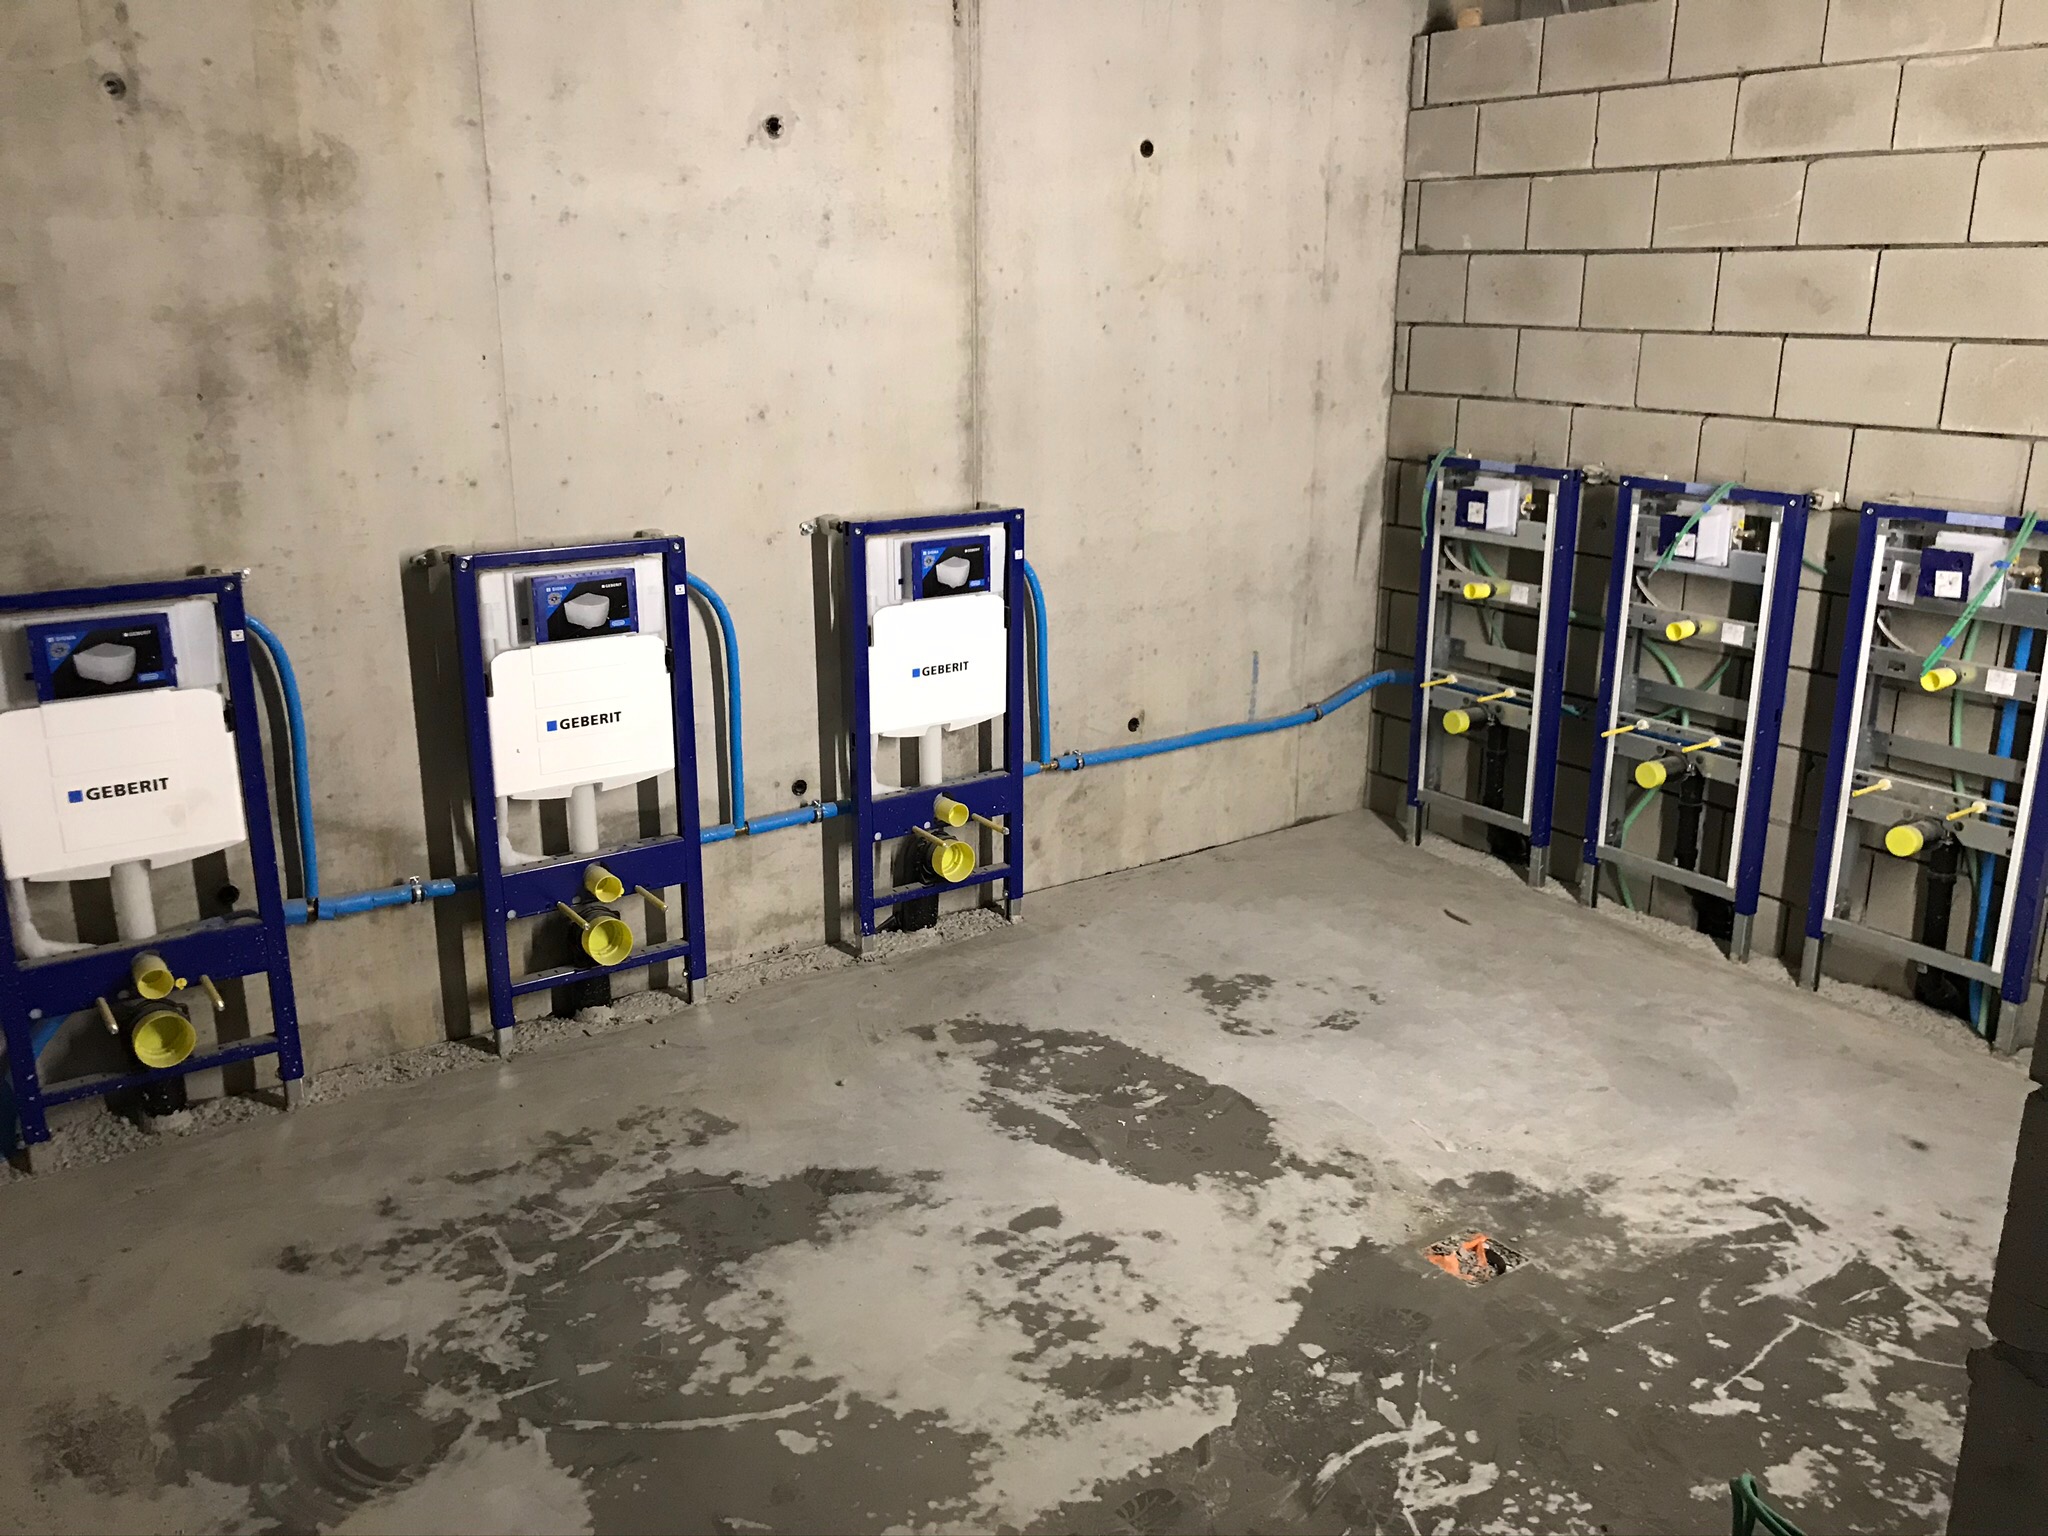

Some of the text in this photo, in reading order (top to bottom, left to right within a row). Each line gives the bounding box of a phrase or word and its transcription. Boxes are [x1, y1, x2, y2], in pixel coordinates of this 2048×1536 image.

[922, 661, 969, 677] GEBERIT
[560, 711, 622, 730] GEBERIT
[86, 777, 169, 801] GEBERIT
